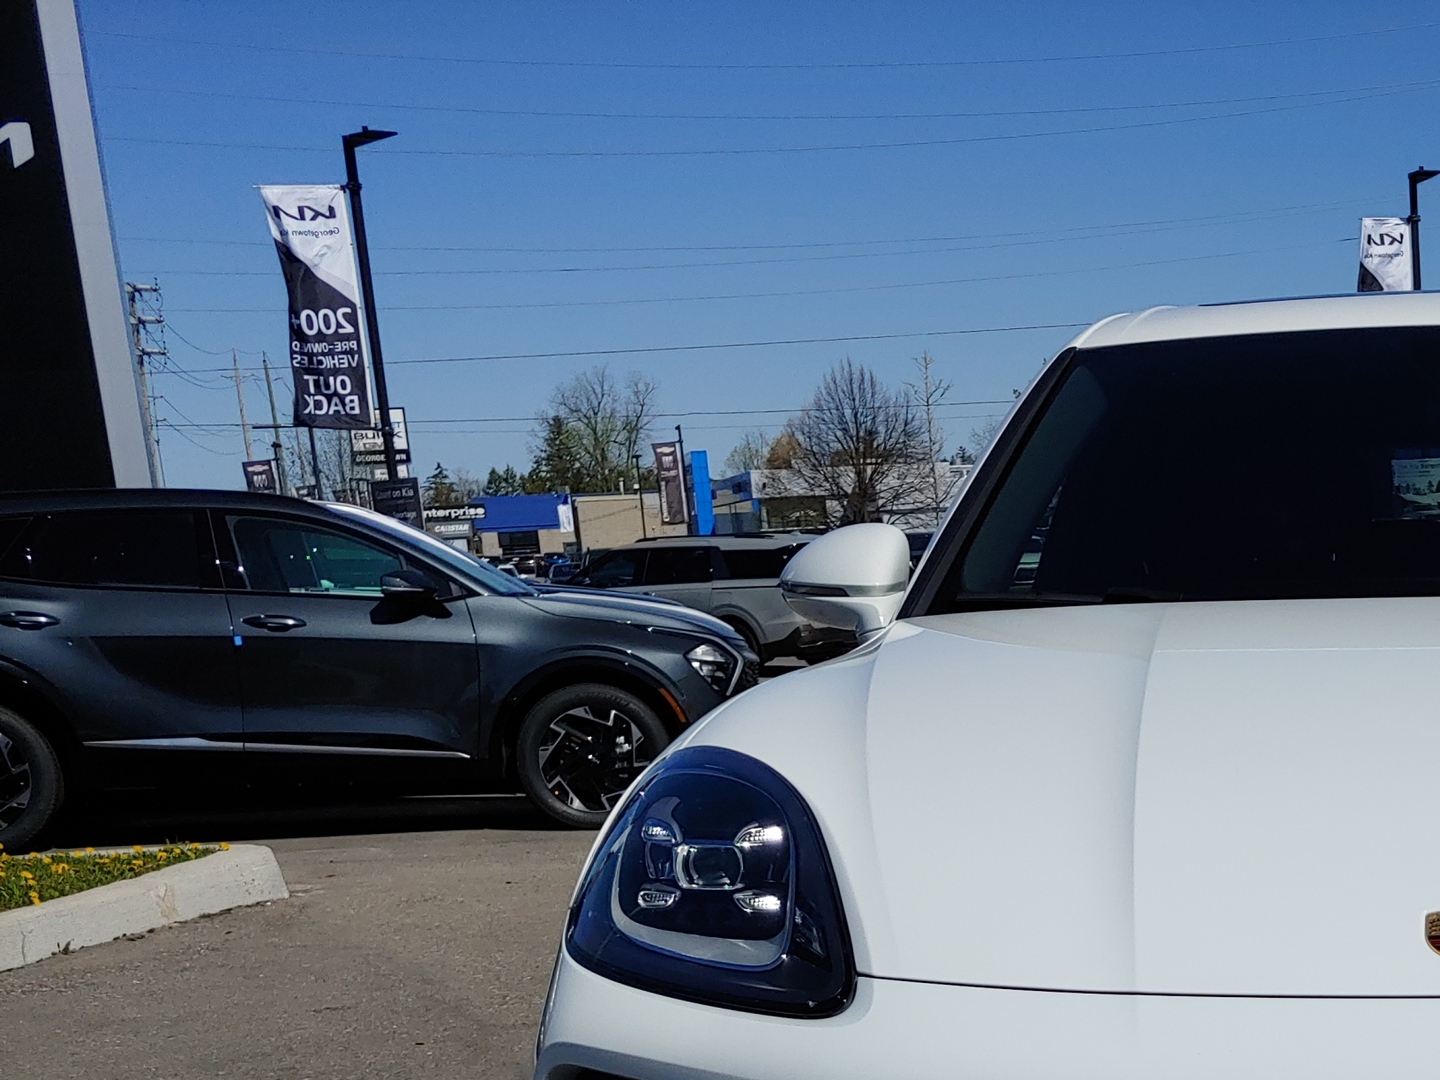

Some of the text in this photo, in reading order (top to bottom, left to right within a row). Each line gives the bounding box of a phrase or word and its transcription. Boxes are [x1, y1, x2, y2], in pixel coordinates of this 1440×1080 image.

[354, 431, 403, 440] BUIK
[356, 454, 407, 462] GEORGEWN
[401, 487, 415, 497] Kia
[422, 506, 485, 519] nterprise
